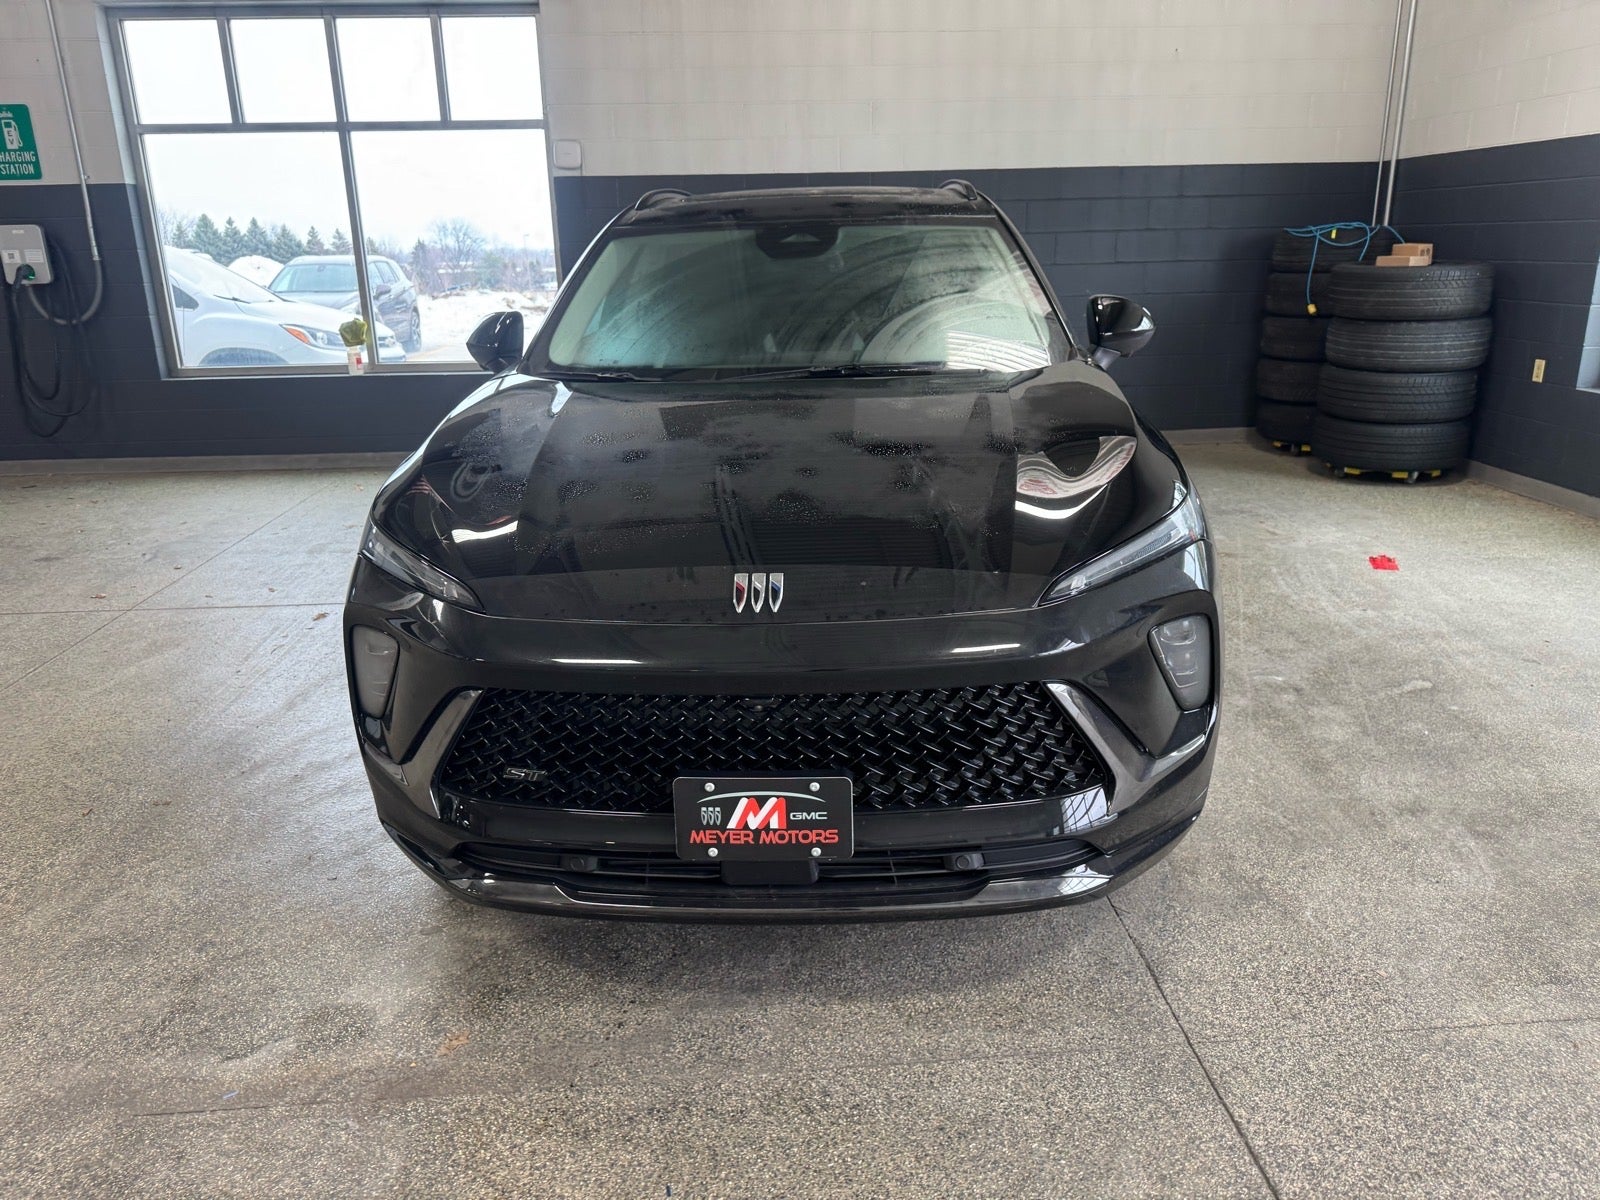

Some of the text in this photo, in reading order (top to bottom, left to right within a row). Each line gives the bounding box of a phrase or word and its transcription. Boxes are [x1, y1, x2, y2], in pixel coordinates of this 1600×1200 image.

[0, 151, 36, 162] HARGING
[0, 163, 34, 175] STATION
[503, 767, 547, 781] ST
[790, 811, 828, 820] GMC
[689, 829, 839, 845] MEYER MOTORS
